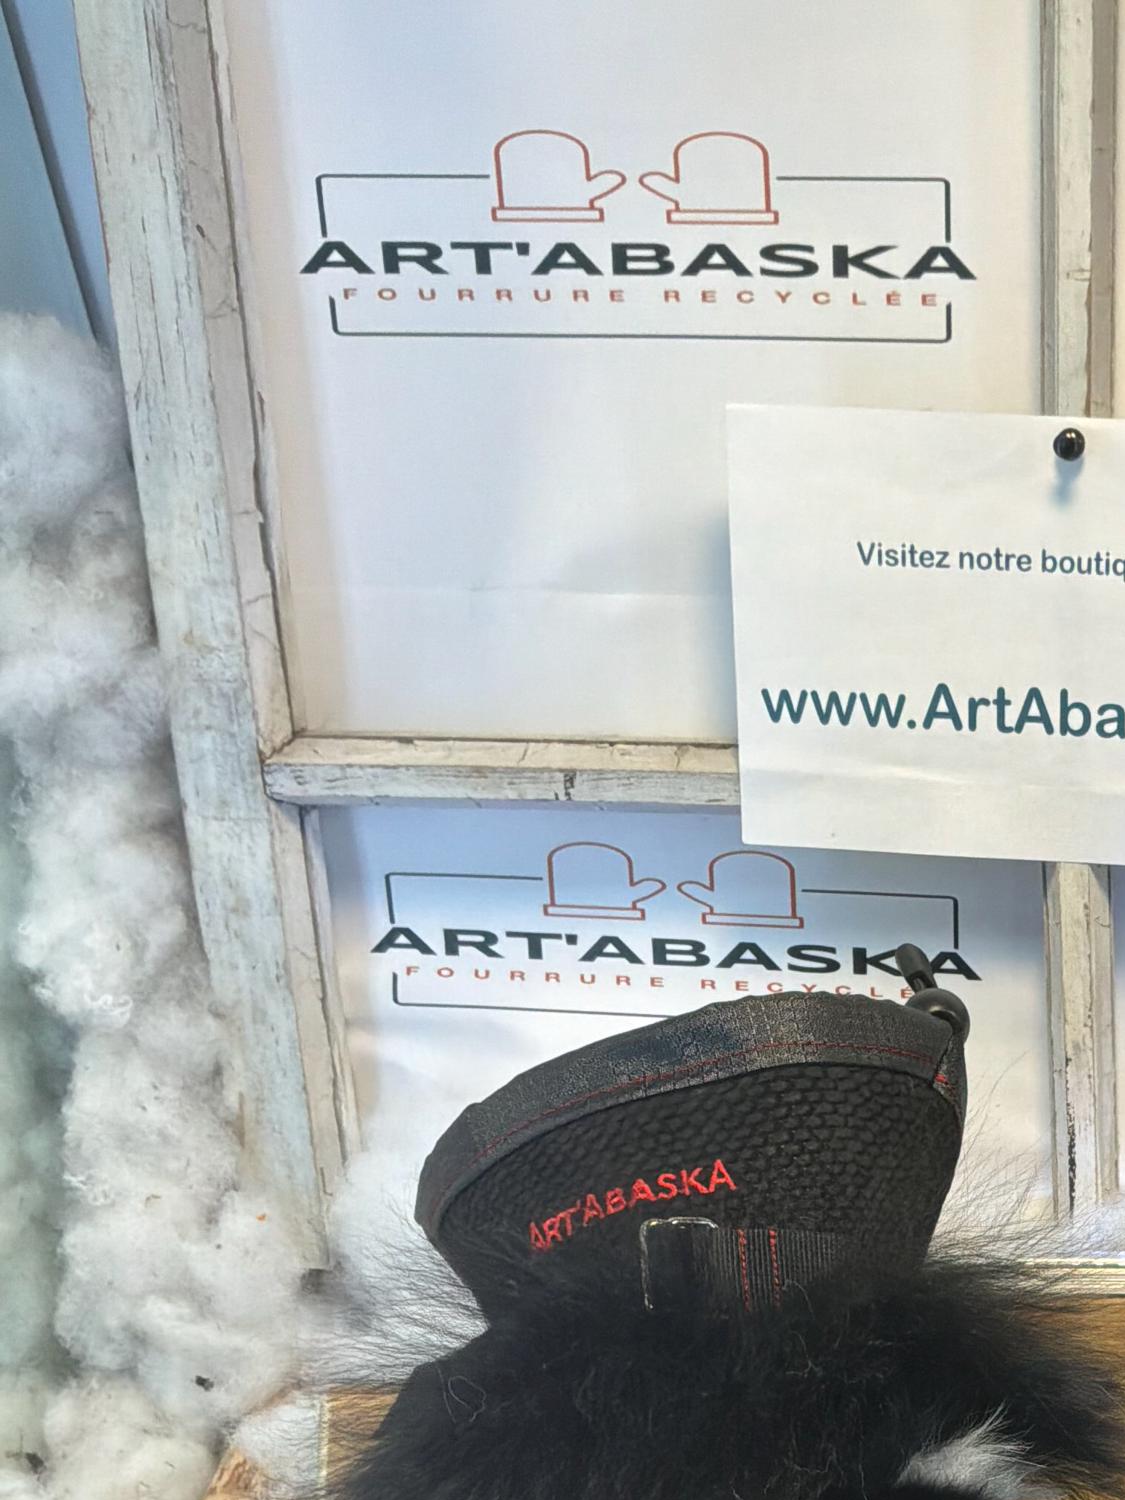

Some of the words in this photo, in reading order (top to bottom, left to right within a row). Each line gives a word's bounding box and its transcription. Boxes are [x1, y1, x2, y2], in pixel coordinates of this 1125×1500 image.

[299, 240, 976, 280] ART'ABASKA
[343, 287, 625, 304] FOURRURE
[663, 288, 938, 307] RECYCLÉE
[856, 541, 951, 569] Visitez
[958, 547, 1033, 573] notre
[371, 927, 983, 981] ART'ABASKA
[405, 965, 664, 989] FOURRURE
[700, 977, 913, 999] RECYCLÉ
